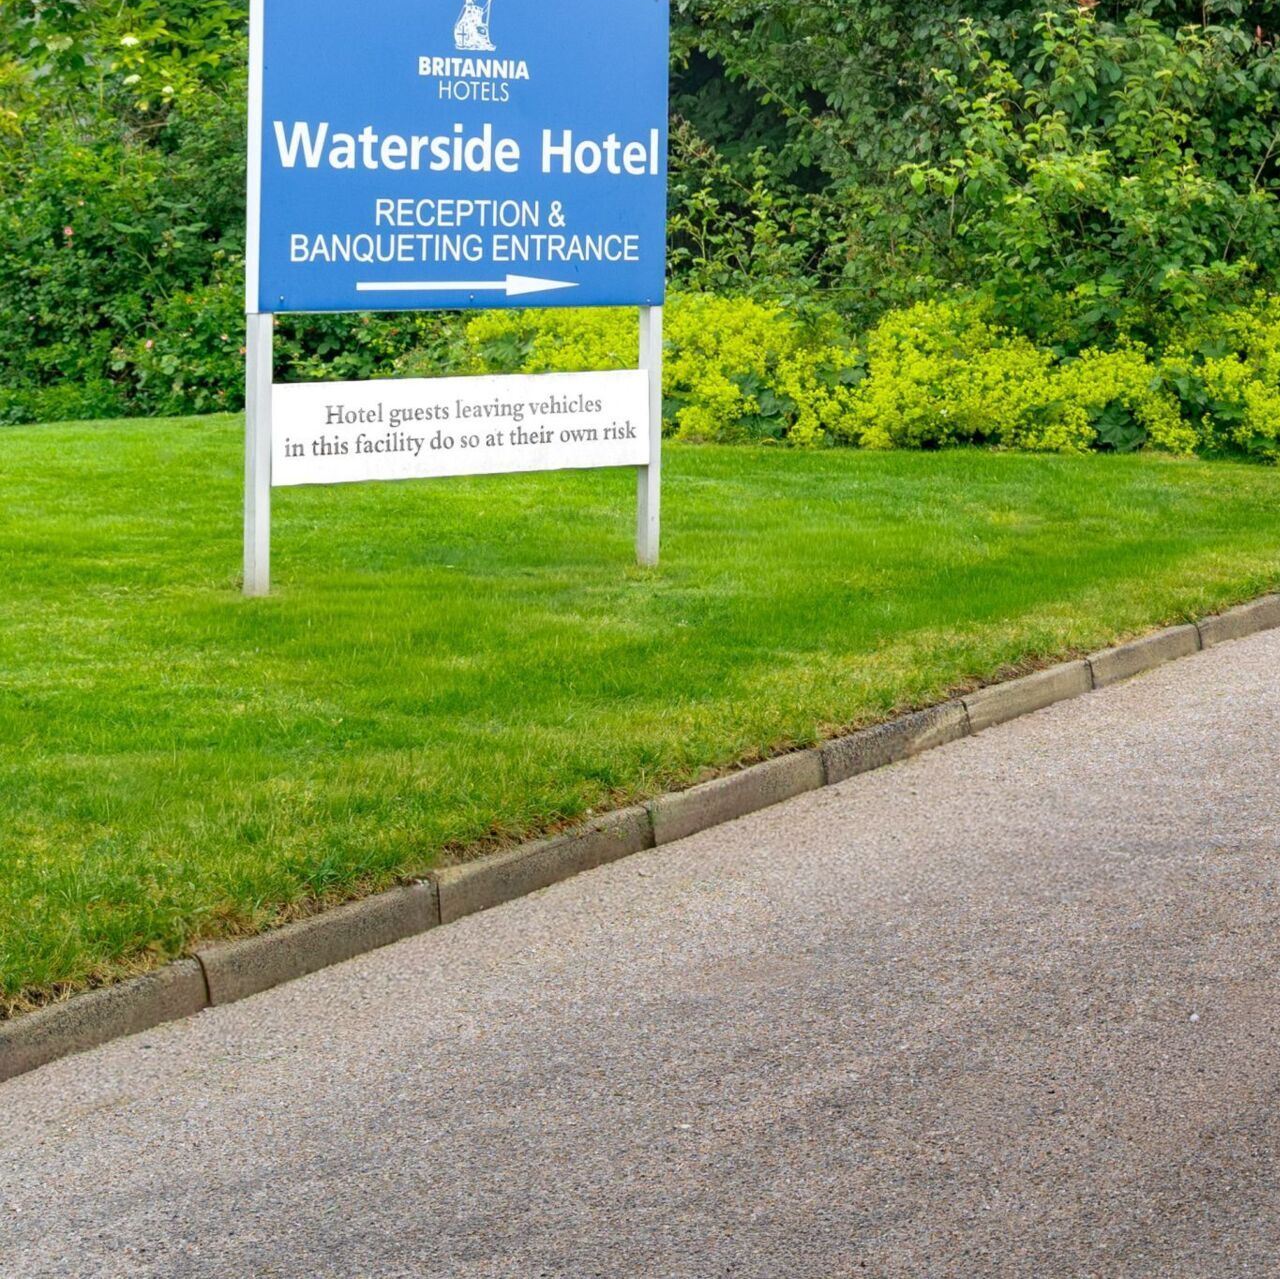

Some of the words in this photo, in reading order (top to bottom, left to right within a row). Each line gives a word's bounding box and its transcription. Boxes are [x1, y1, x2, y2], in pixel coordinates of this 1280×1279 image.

[418, 56, 530, 80] BRITANNIA
[439, 80, 510, 102] HOTELS
[273, 121, 520, 173] Waterside
[542, 128, 658, 175] Hotel
[375, 198, 539, 228] RECEPTION
[548, 201, 566, 227] &
[290, 233, 483, 263] BANQUETING
[492, 235, 639, 261] ENTRANCE
[325, 402, 383, 424] Hotel
[389, 404, 449, 428] guests
[455, 398, 525, 421] leaving
[529, 393, 602, 415] vehicles
[285, 437, 305, 457] in
[312, 435, 349, 456] this
[355, 432, 425, 457] facility
[430, 430, 455, 450] do
[460, 433, 480, 448] so
[486, 430, 504, 446] at
[510, 425, 554, 446] their
[559, 428, 598, 442] own
[603, 420, 637, 440] risk
